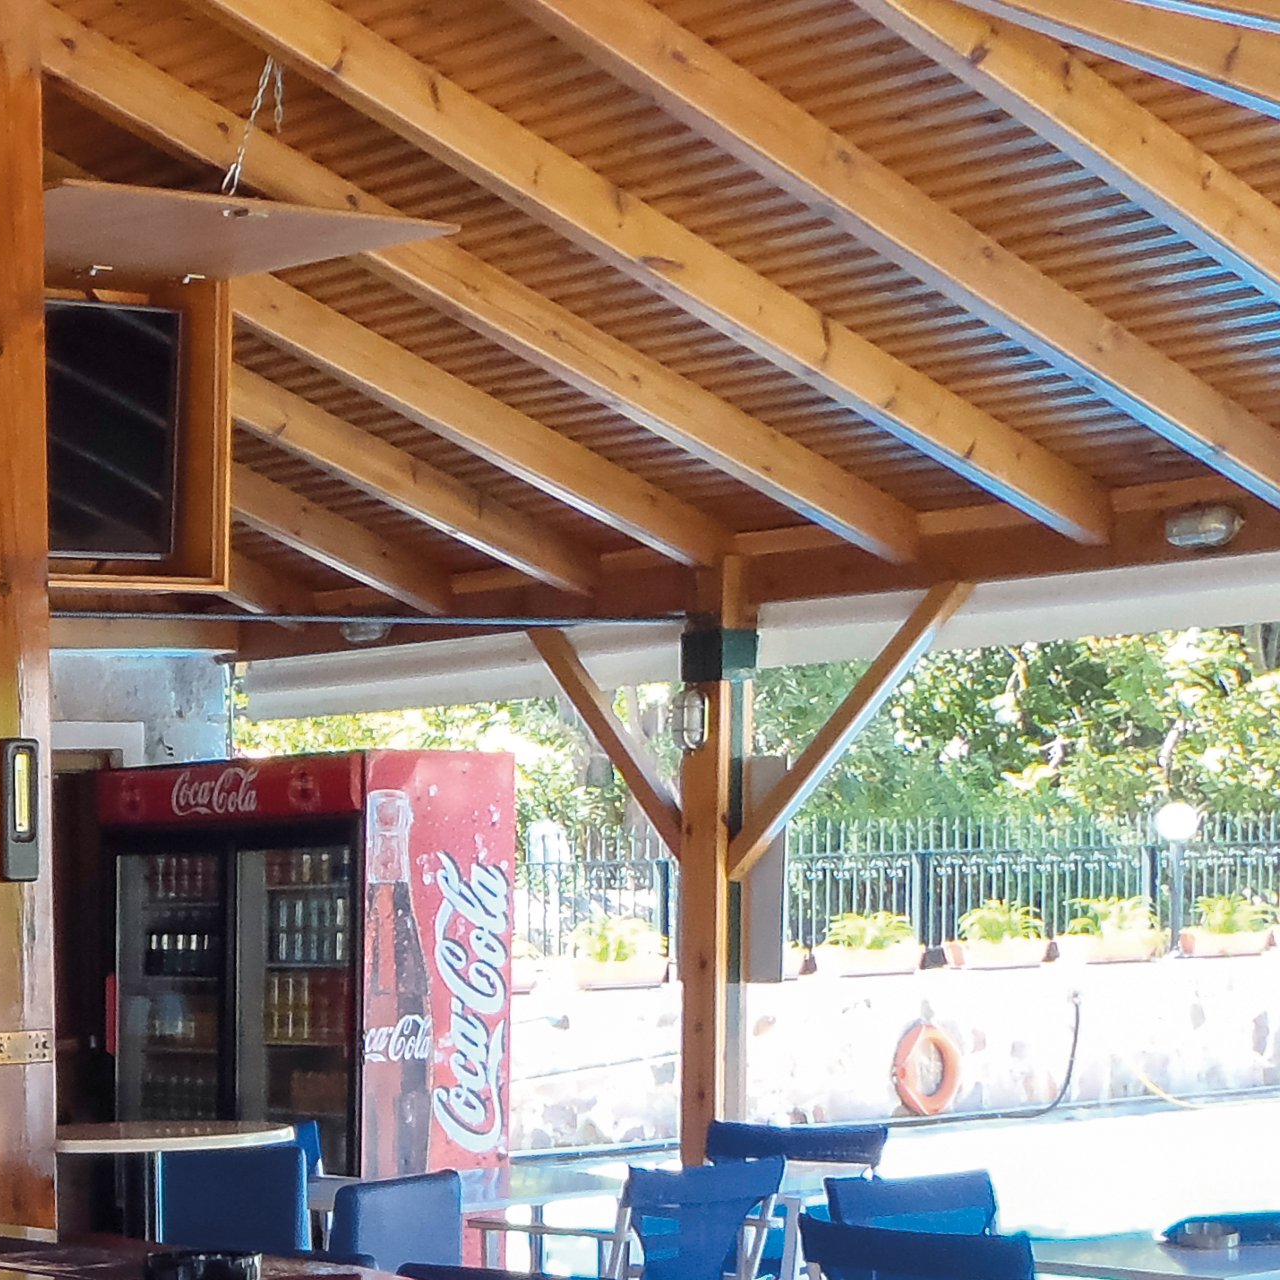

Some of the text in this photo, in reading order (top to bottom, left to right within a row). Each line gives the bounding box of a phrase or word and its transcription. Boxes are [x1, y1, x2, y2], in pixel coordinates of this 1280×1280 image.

[171, 767, 258, 816] Coca-Cola
[434, 850, 509, 1154] Coca-Cola
[362, 1013, 432, 1062] ca-Cola
